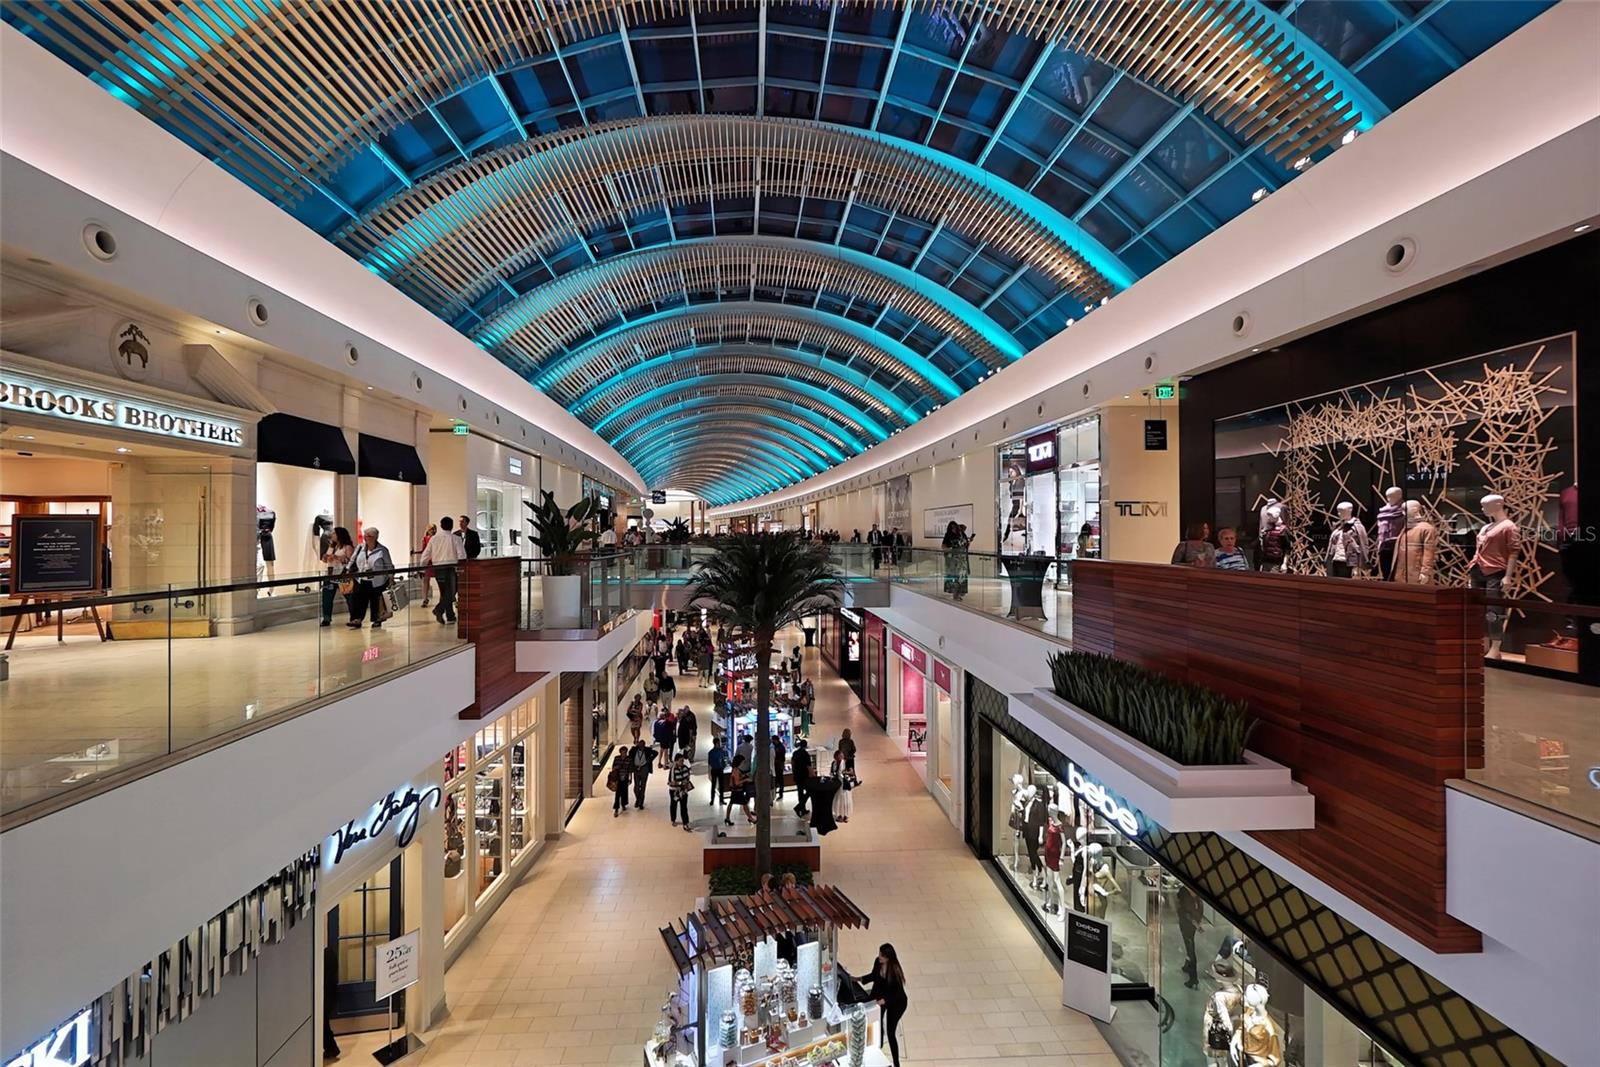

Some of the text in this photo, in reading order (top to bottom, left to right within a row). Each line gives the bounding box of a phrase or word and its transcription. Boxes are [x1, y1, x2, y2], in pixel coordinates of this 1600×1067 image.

[124, 406, 244, 444] BROTHERS
[1028, 440, 1056, 462] TUMI
[1114, 501, 1168, 518] TUMI
[1068, 762, 1139, 837] bebe
[332, 819, 368, 865] Vera
[1075, 921, 1101, 934] bebe
[6, 1008, 93, 1067] KI
